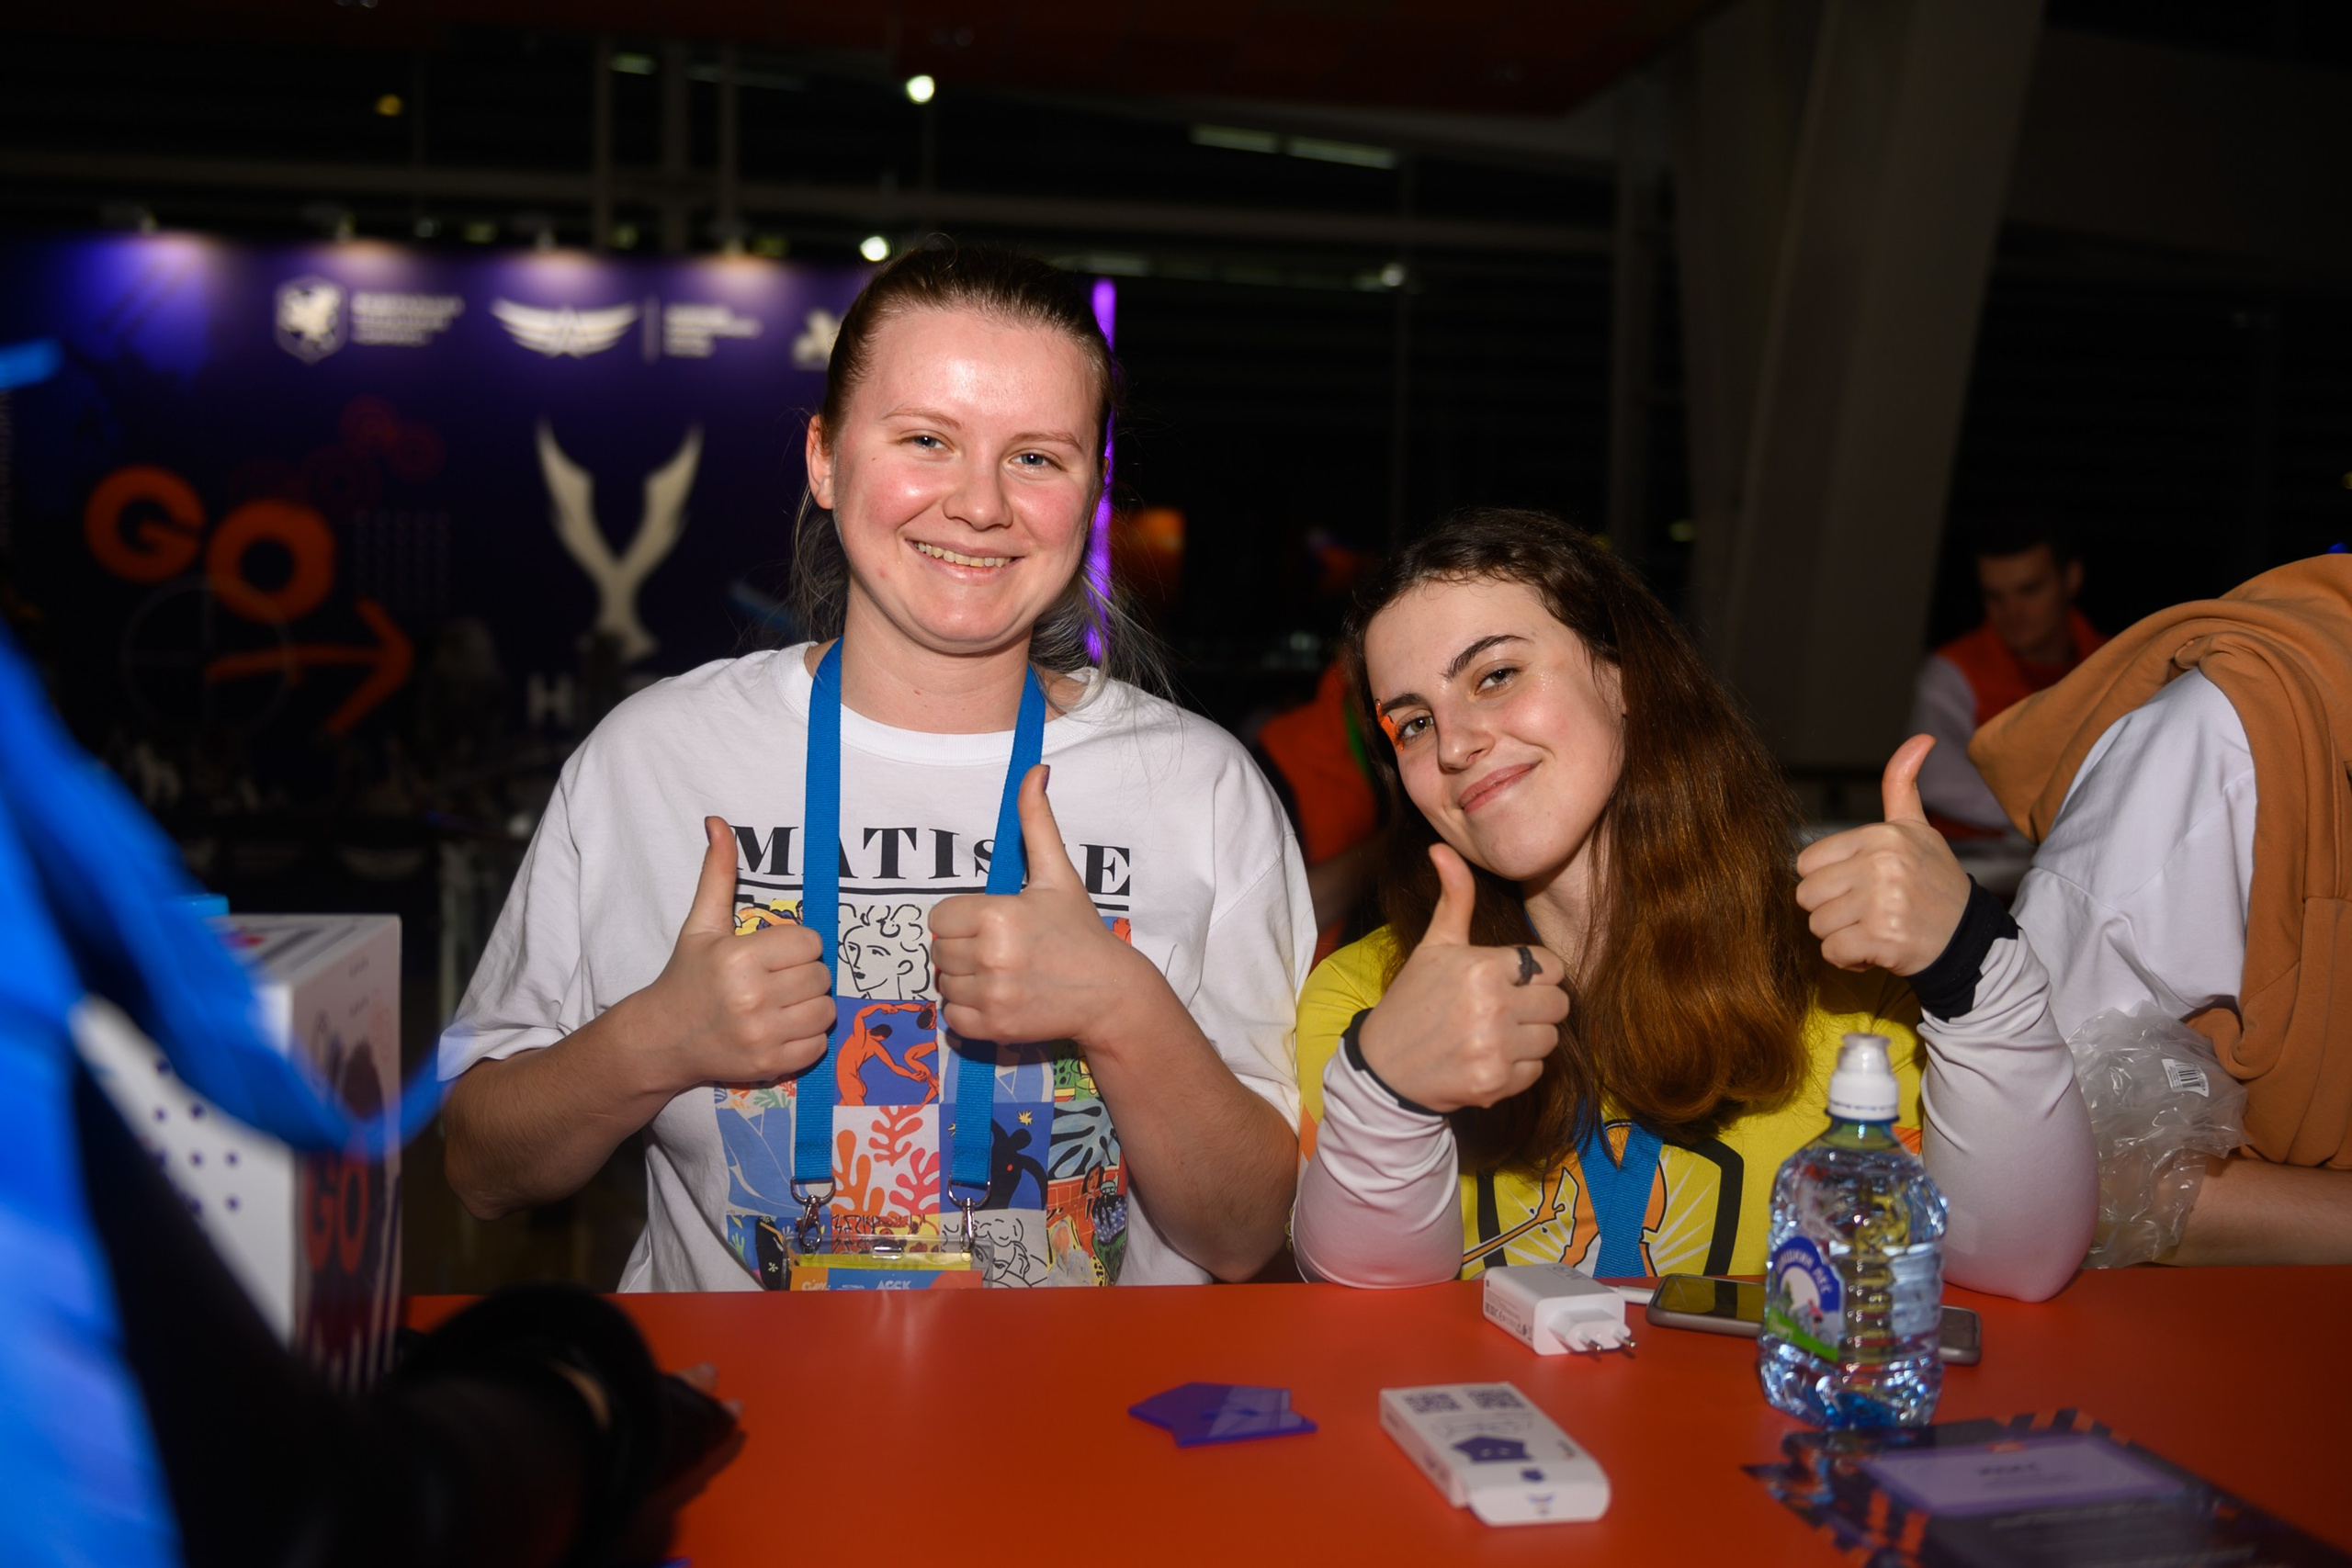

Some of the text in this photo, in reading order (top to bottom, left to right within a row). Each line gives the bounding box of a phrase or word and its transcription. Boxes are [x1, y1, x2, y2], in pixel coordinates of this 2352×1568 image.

[84, 463, 338, 625] GO
[733, 824, 1131, 897] MTISE
[305, 1145, 370, 1276] GO
